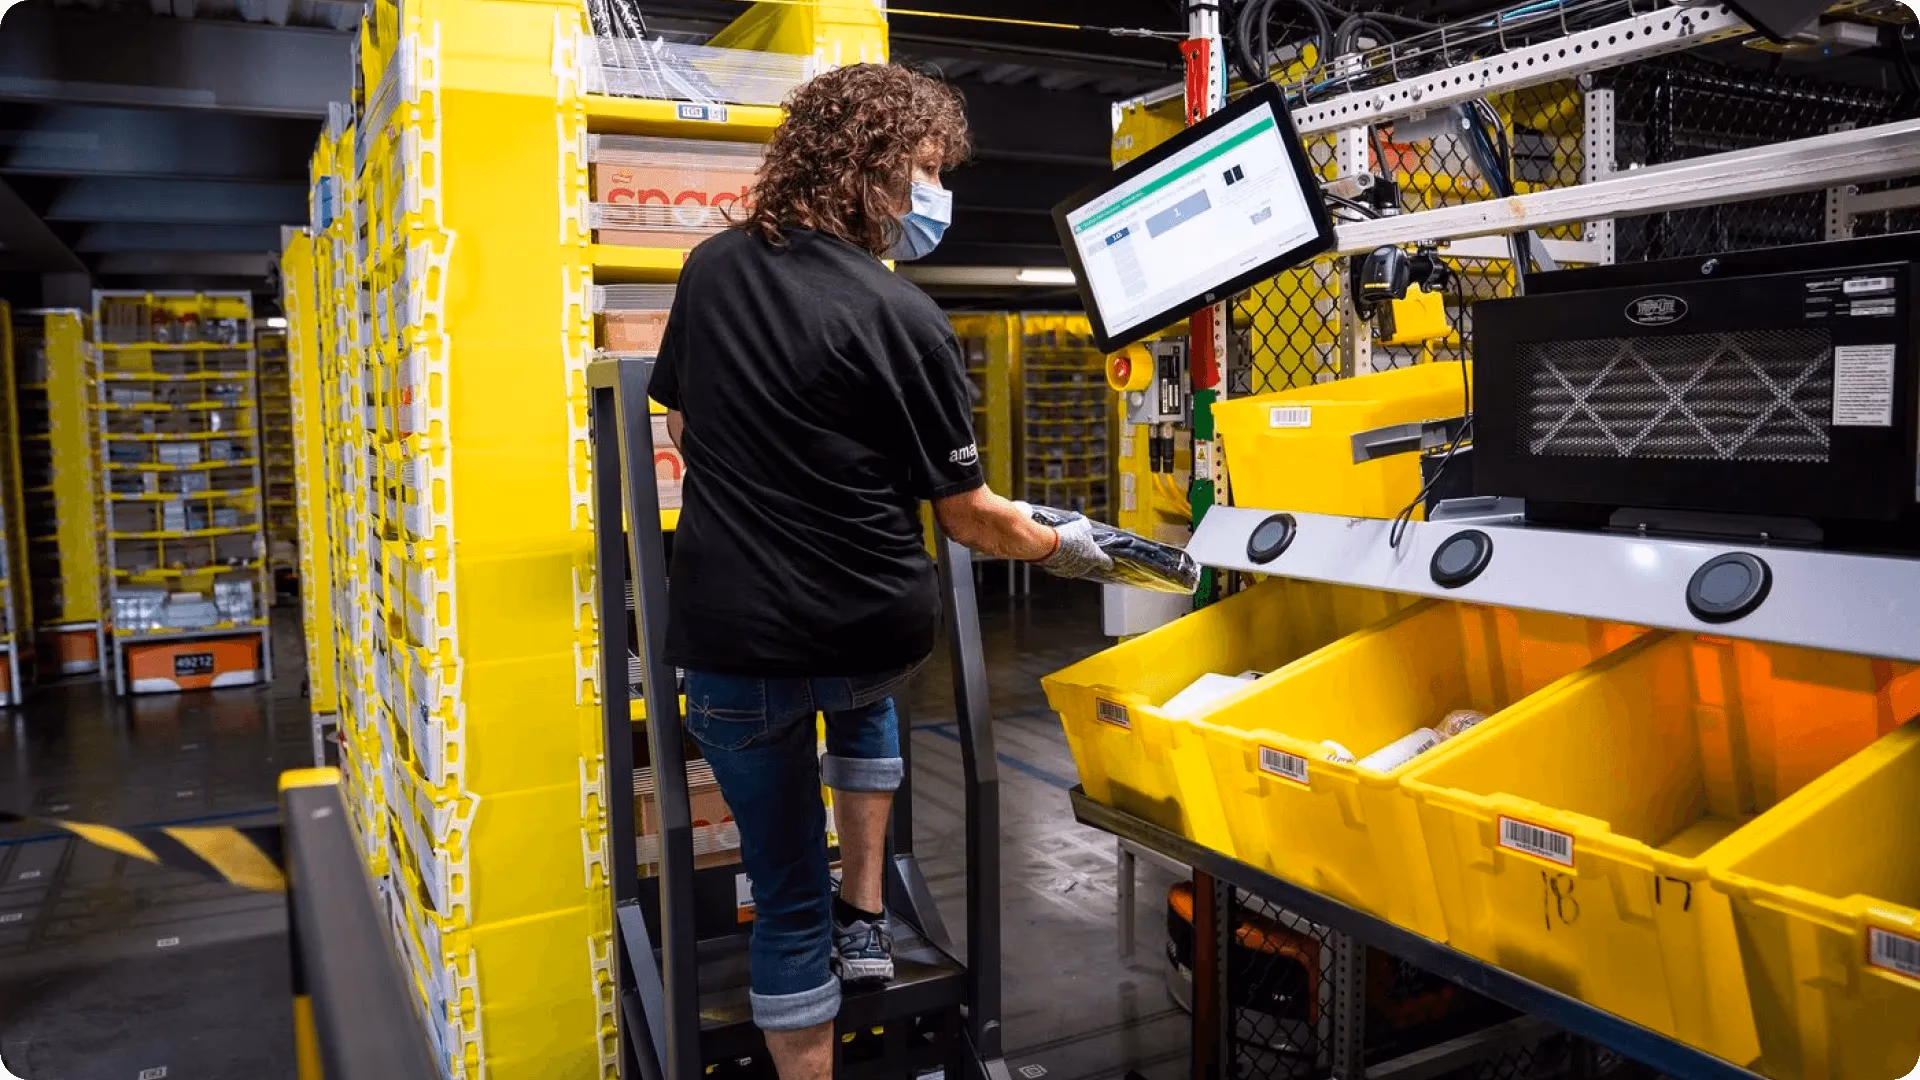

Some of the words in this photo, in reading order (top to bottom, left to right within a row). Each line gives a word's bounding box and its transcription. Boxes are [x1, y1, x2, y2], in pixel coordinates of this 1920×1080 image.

[948, 443, 978, 463] ama
[1541, 870, 1580, 931] 18
[1653, 875, 1692, 912] 17
